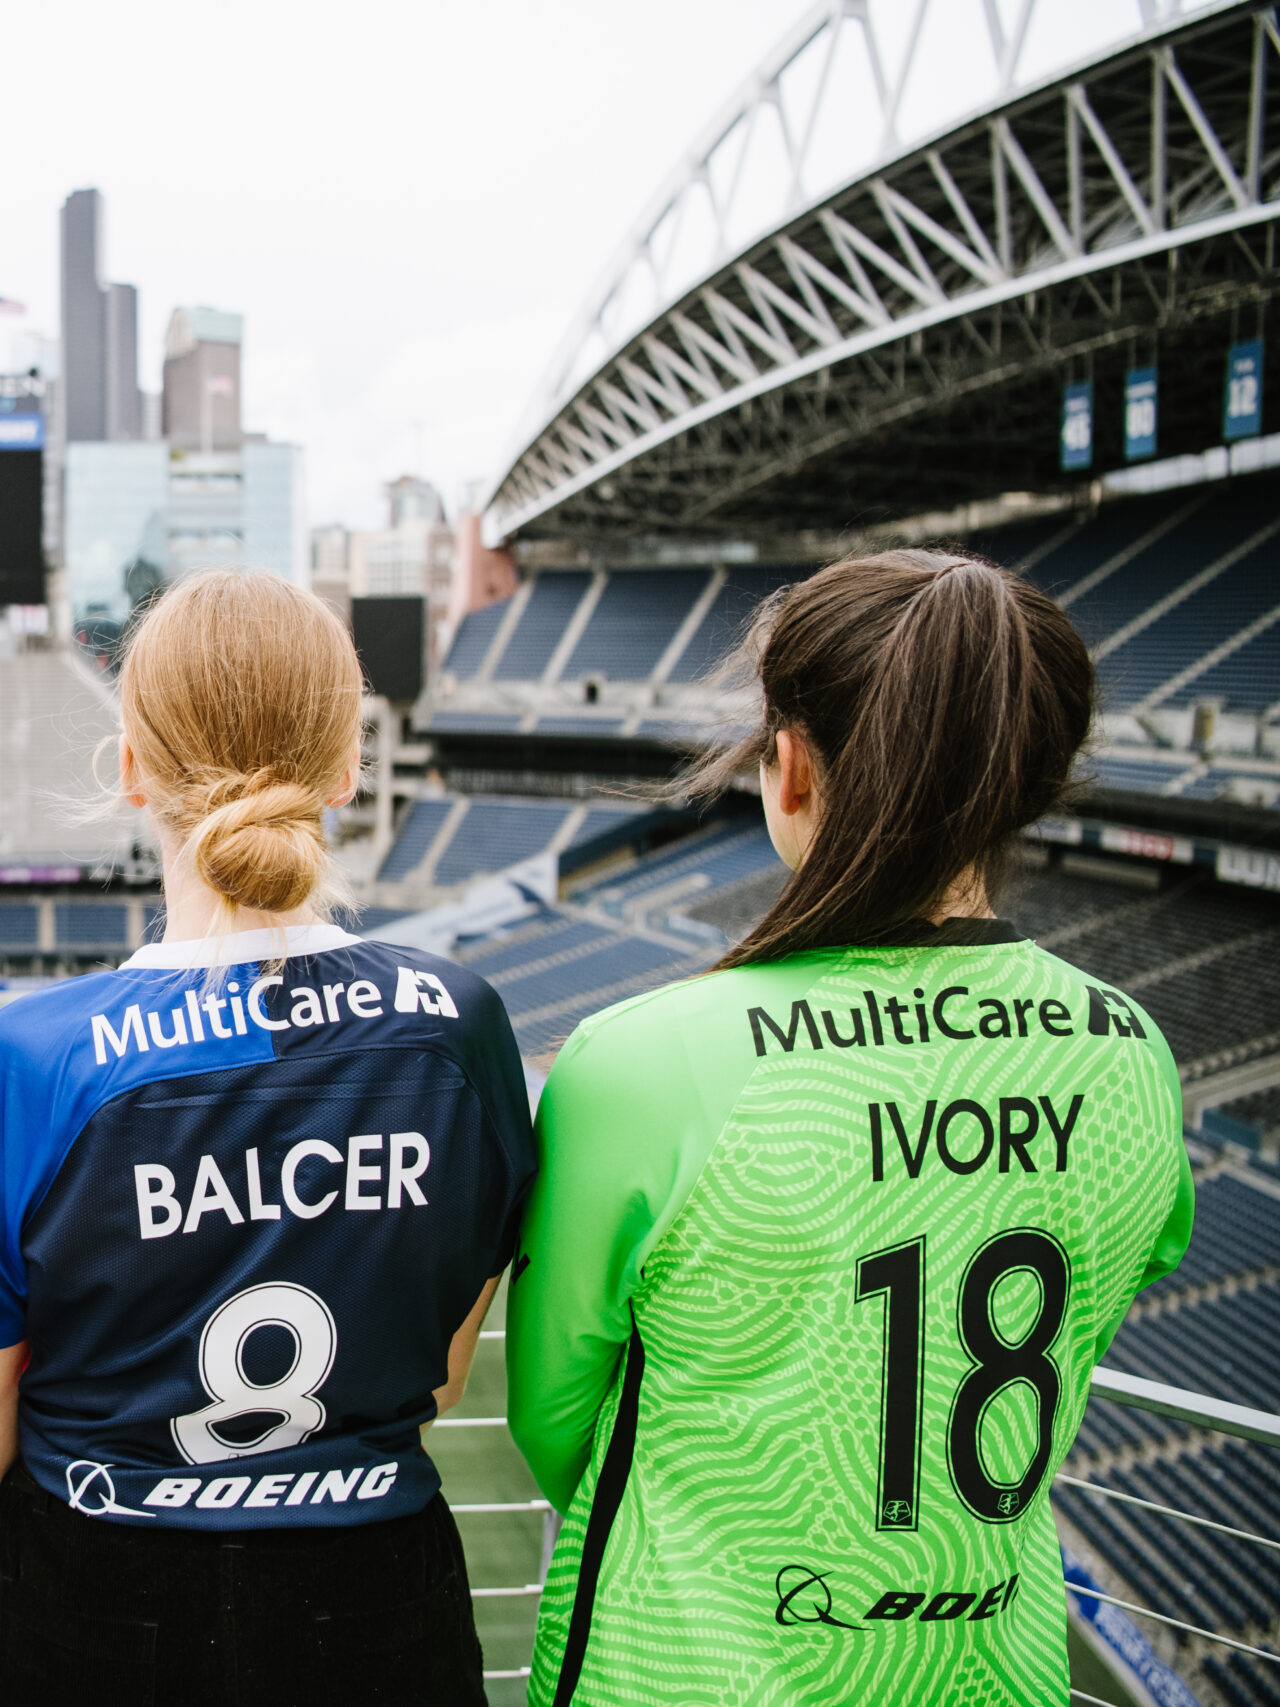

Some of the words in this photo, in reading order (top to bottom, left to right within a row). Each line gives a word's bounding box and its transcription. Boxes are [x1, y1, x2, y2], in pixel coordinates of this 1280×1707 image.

[91, 976, 384, 1065] MultiCare
[746, 986, 1072, 1057] MultiCare
[868, 1094, 1085, 1182] IVORY
[134, 1131, 431, 1240] BALCER
[170, 1280, 338, 1465] 8
[854, 1225, 1072, 1533] 18
[143, 1461, 398, 1509] BOEING
